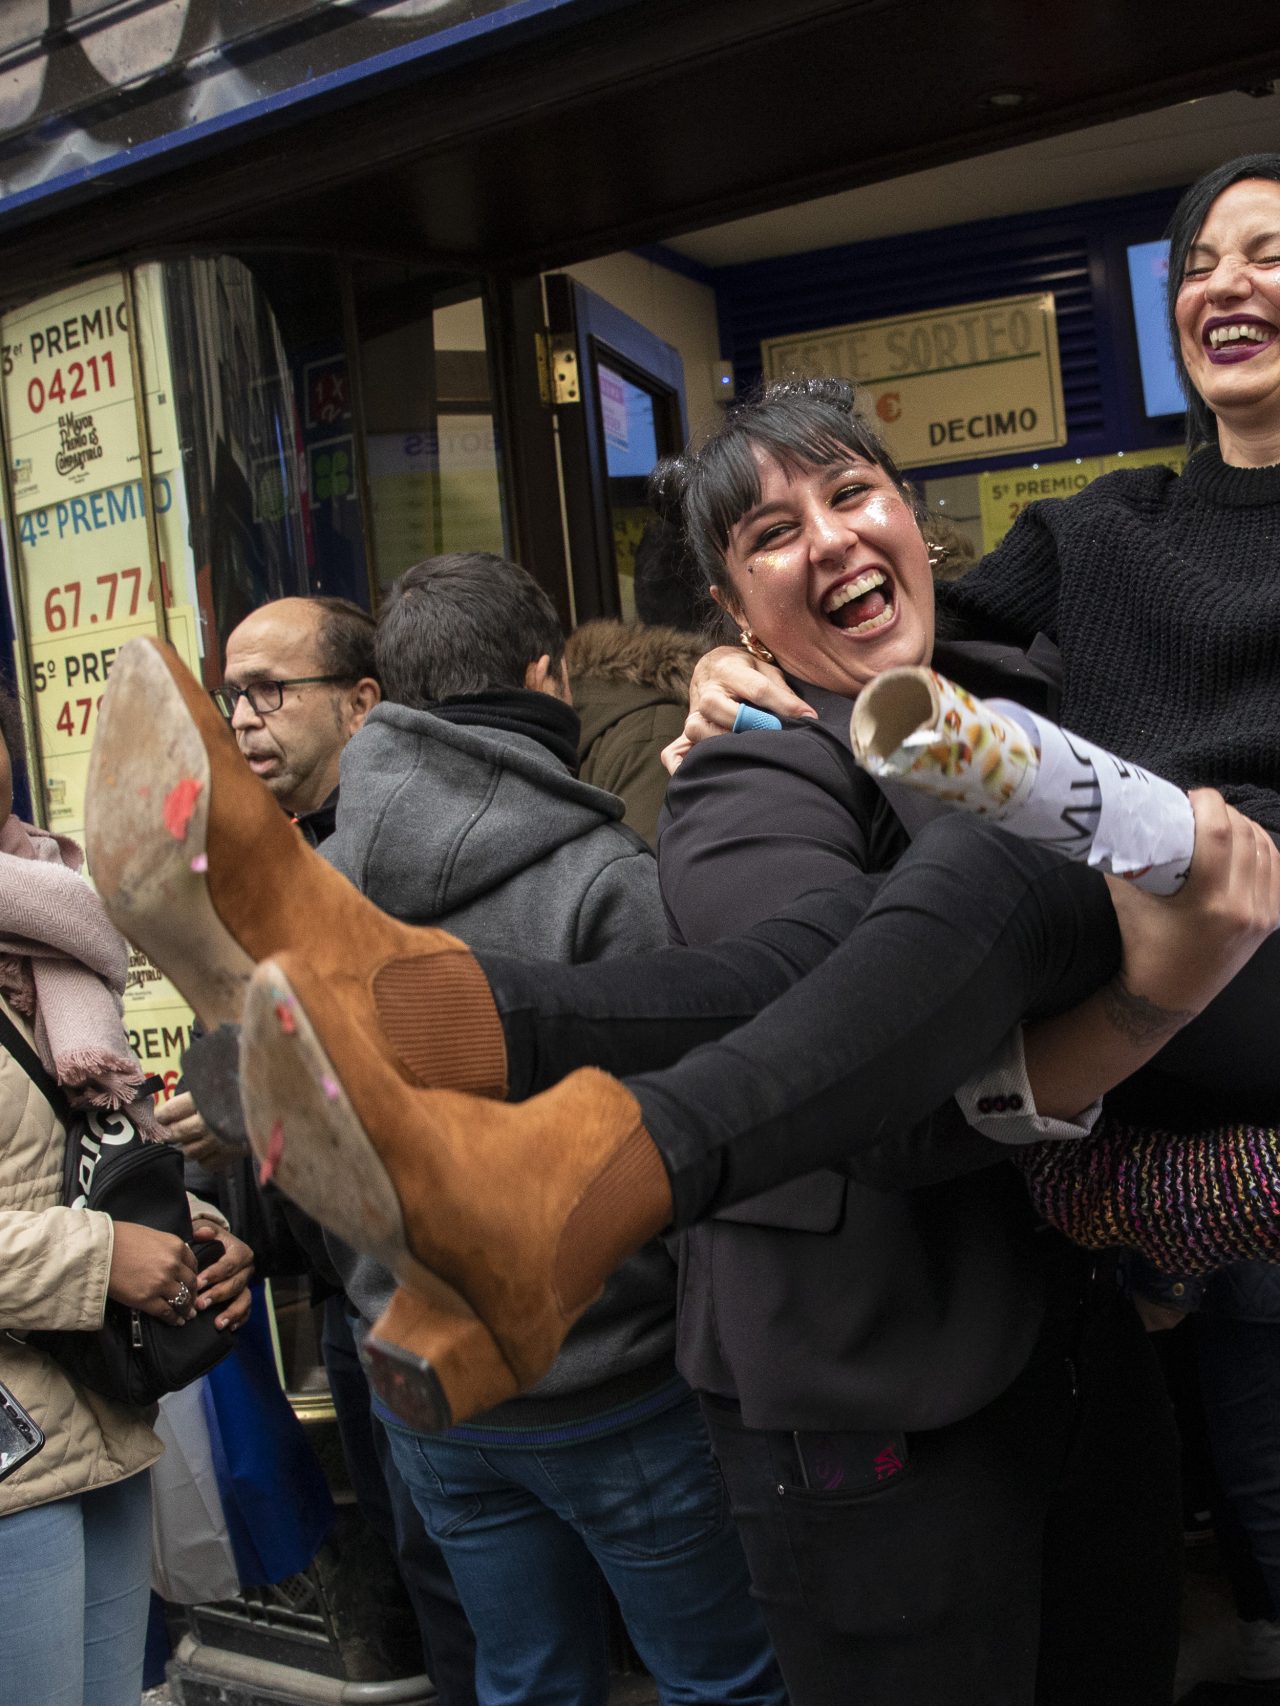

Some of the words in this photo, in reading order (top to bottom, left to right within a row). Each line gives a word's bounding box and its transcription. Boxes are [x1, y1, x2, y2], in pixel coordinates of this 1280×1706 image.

[884, 308, 1032, 372] SORTEO
[27, 350, 117, 414] 04211
[928, 407, 1038, 447] DECIMO
[1015, 474, 1089, 497] PREMIO
[20, 509, 50, 547] 4º
[55, 476, 173, 540] PREMIO
[33, 659, 56, 693] 5º
[64, 645, 124, 687] PRE
[127, 1024, 195, 1060] REM
